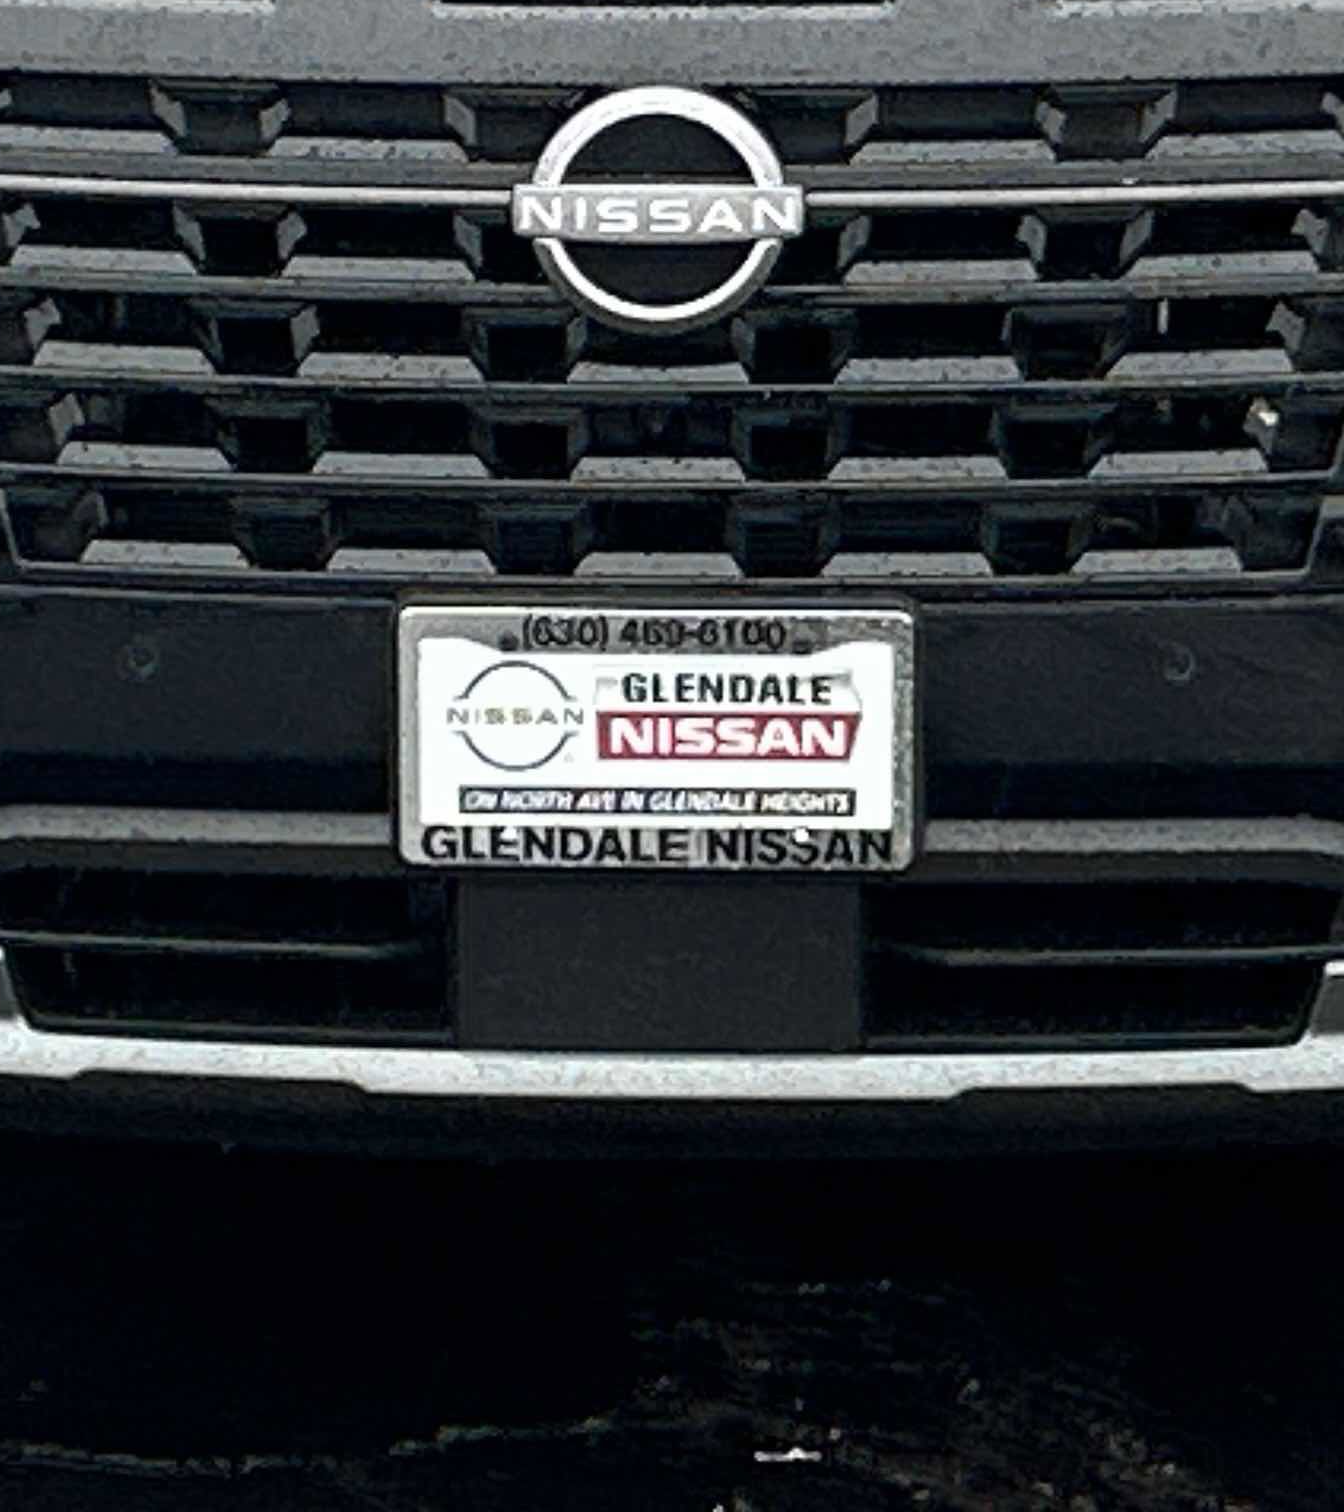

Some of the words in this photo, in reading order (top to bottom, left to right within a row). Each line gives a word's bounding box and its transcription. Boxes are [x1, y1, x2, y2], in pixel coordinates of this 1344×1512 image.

[516, 196, 797, 233] NISSAN
[522, 613, 607, 651] (630)
[622, 673, 830, 704] GLENDALE
[446, 708, 584, 725] NISSAN
[609, 717, 846, 756] NISSAN
[464, 790, 497, 811] ON
[620, 790, 645, 811] IN
[649, 790, 755, 812] GLENDALE
[760, 792, 850, 815] HEIGHTS
[422, 825, 689, 863] GLENDALE
[707, 828, 891, 865] NISSAN
